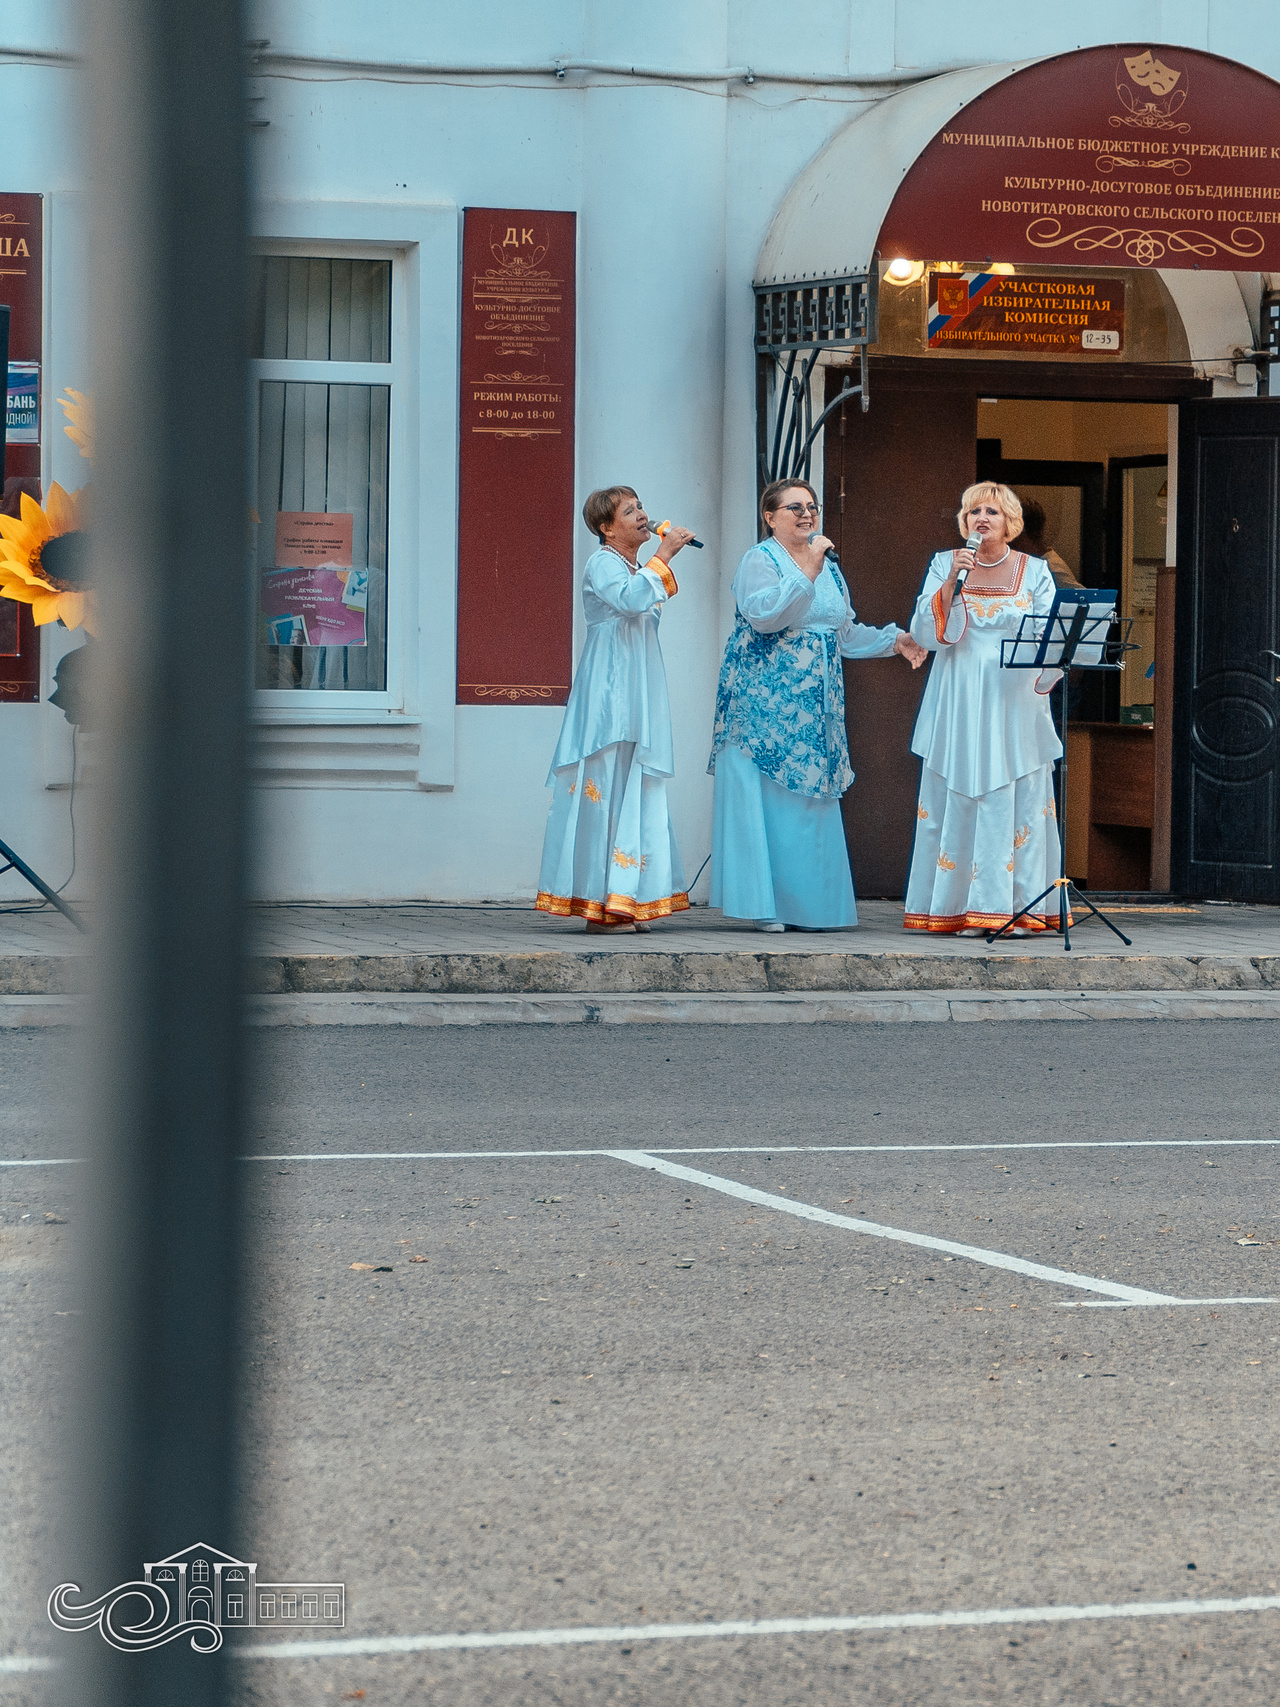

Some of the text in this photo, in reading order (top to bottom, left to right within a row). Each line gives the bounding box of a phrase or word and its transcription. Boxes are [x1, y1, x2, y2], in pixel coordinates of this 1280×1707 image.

[942, 132, 1075, 150] МУНИЦИПАЛЬНОЕ
[1078, 139, 1169, 155] БЮДЖЕТНОЕ
[1172, 143, 1268, 160] УЧРЕЖДЕНИЕ
[1004, 176, 1280, 200] КУЛЬТУРНО-ДОСУГОВОЕ ОБЪЕДИНЕНИЕ
[981, 199, 1130, 218] НОВОТИТАРОВСКОГО
[1134, 207, 1214, 221] СЕЛЬСКОГО
[503, 227, 534, 248] ДК
[998, 281, 1095, 296] УЧАСТКОВАЯ
[982, 295, 1111, 312] ИЗБИРАТЕЛЬНАЯ
[490, 313, 546, 322] ОБЪЕДИНЕНИЕ
[1004, 311, 1089, 326] КОМИССИЯ
[936, 330, 1022, 342] ИЗБИРАТЕЛЬНОГО
[1024, 332, 1066, 344] УЧАСТКА
[1069, 333, 1080, 344] №
[473, 391, 562, 403] РЕЖИМ РАБОТЫ:
[479, 409, 555, 420] с 8-00 до 18-00
